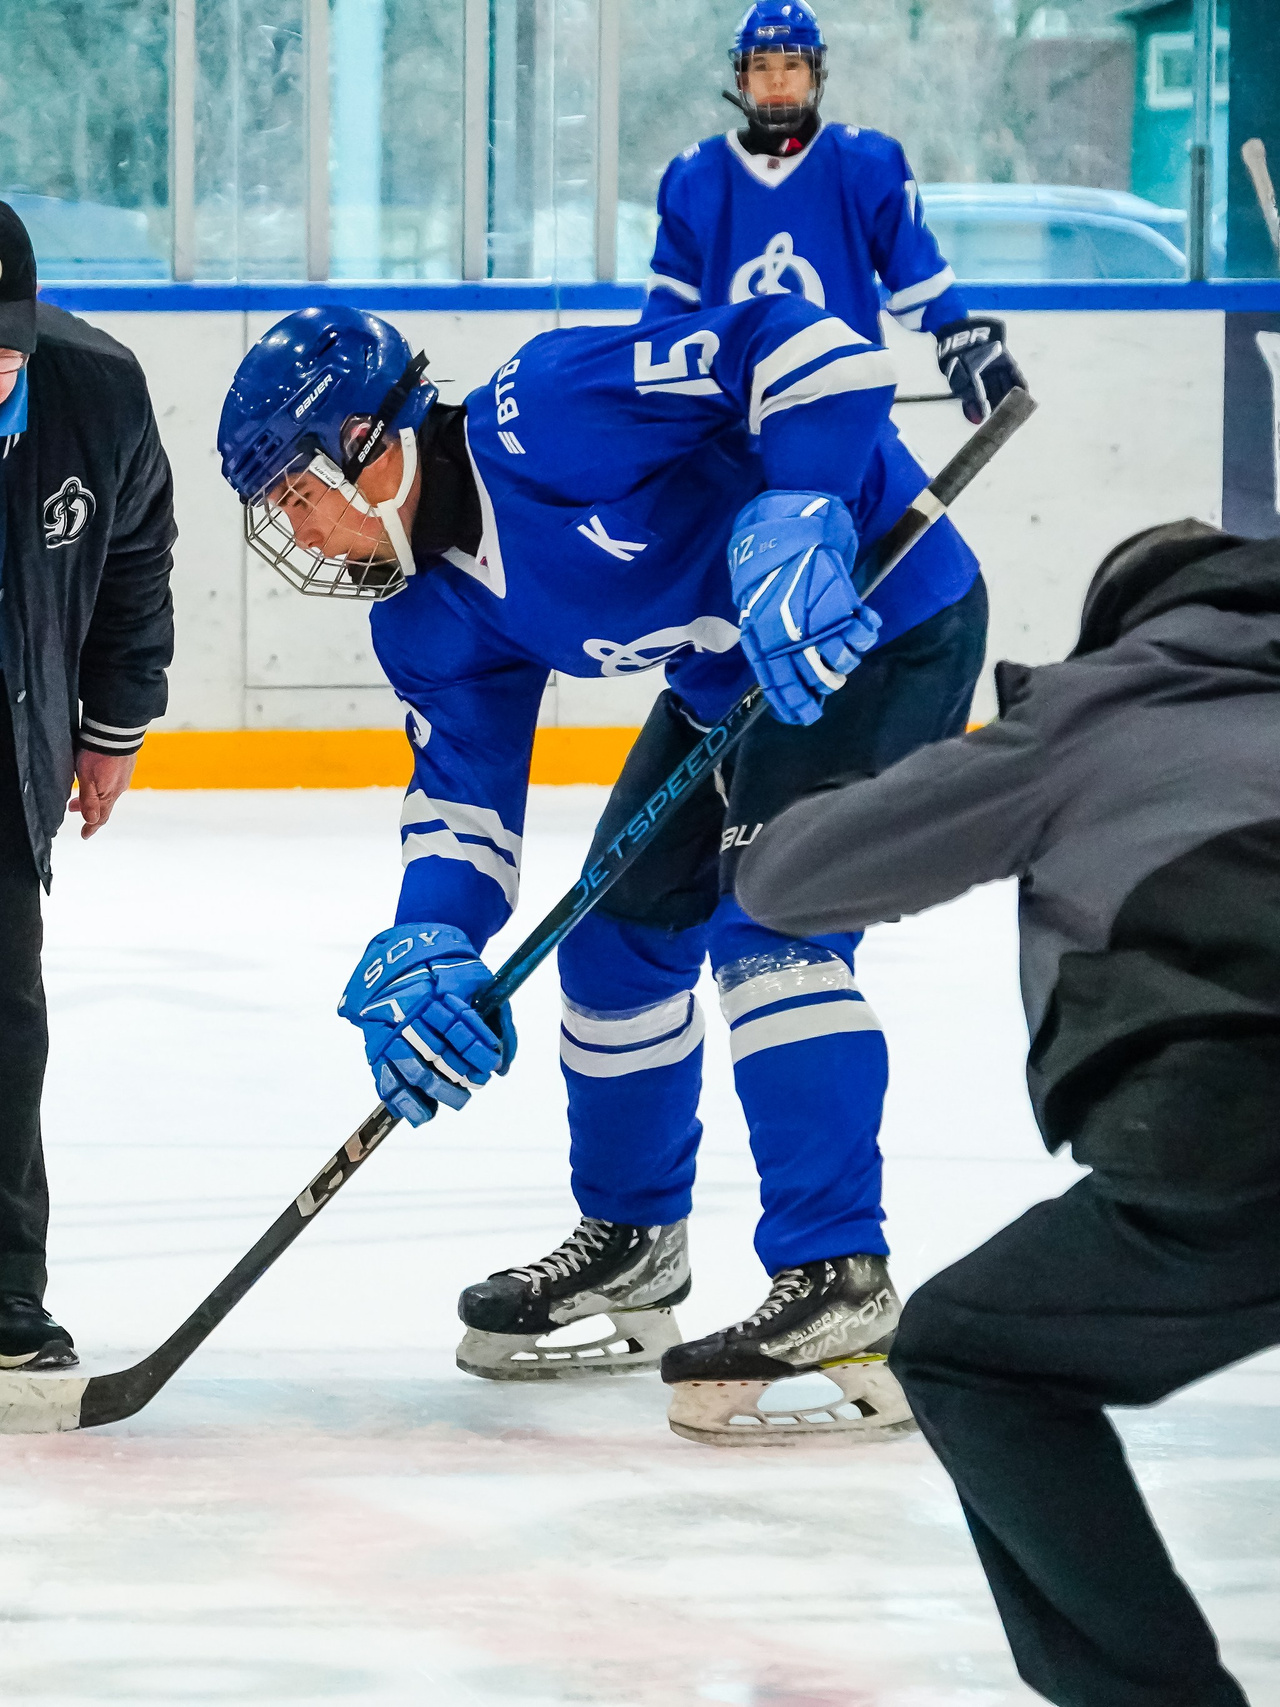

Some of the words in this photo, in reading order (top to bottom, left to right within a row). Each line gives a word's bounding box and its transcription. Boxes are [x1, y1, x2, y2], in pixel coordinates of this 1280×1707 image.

[634, 329, 723, 396] 15
[938, 326, 991, 359] UER
[295, 373, 334, 418] BAUER
[357, 419, 385, 463] BAUER
[572, 725, 728, 911] JETSPEED
[363, 929, 440, 990] SOY
